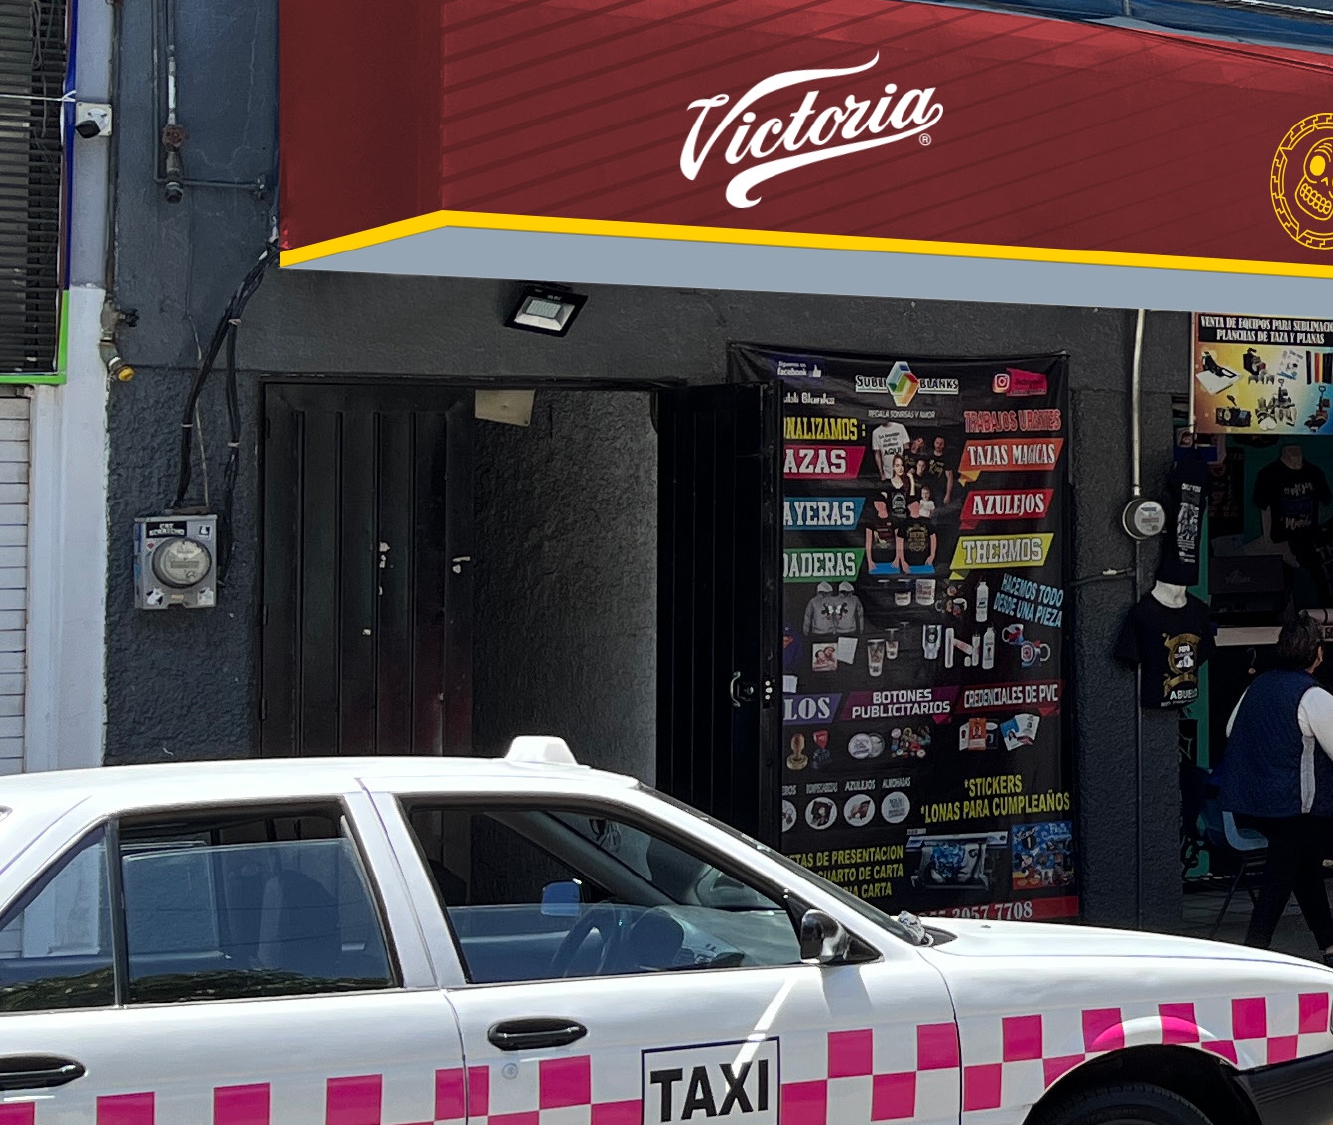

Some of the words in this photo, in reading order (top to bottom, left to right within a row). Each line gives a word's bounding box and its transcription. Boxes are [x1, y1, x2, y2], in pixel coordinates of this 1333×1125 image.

[678, 48, 945, 209] Victoria
[1226, 317, 1237, 328] DE
[1257, 330, 1269, 342] DE
[783, 416, 858, 441] NALIZAMOS
[783, 448, 847, 474] AZAS
[967, 444, 1008, 467] TAZAS
[783, 501, 855, 526] AYERAS
[972, 492, 1045, 517] AZULEJOS
[962, 537, 1043, 566] THERMOS
[1039, 584, 1064, 608] TODO
[1034, 603, 1063, 628] PIEZA
[873, 688, 933, 705] BOTONES
[1025, 685, 1037, 704] DE
[1037, 684, 1059, 704] PVC
[783, 696, 831, 721] LOS
[852, 701, 952, 720] PUBLICITARIOS
[963, 798, 990, 820] PARA
[993, 788, 1071, 816] CUMPLEAÑOS
[816, 851, 829, 866] DE
[832, 845, 904, 866] PRESENTACION
[858, 866, 872, 881] DE
[874, 863, 904, 879] CARTA
[861, 881, 893, 899] CARTA
[995, 900, 1034, 921] 7708
[649, 1059, 770, 1121] TAXI
